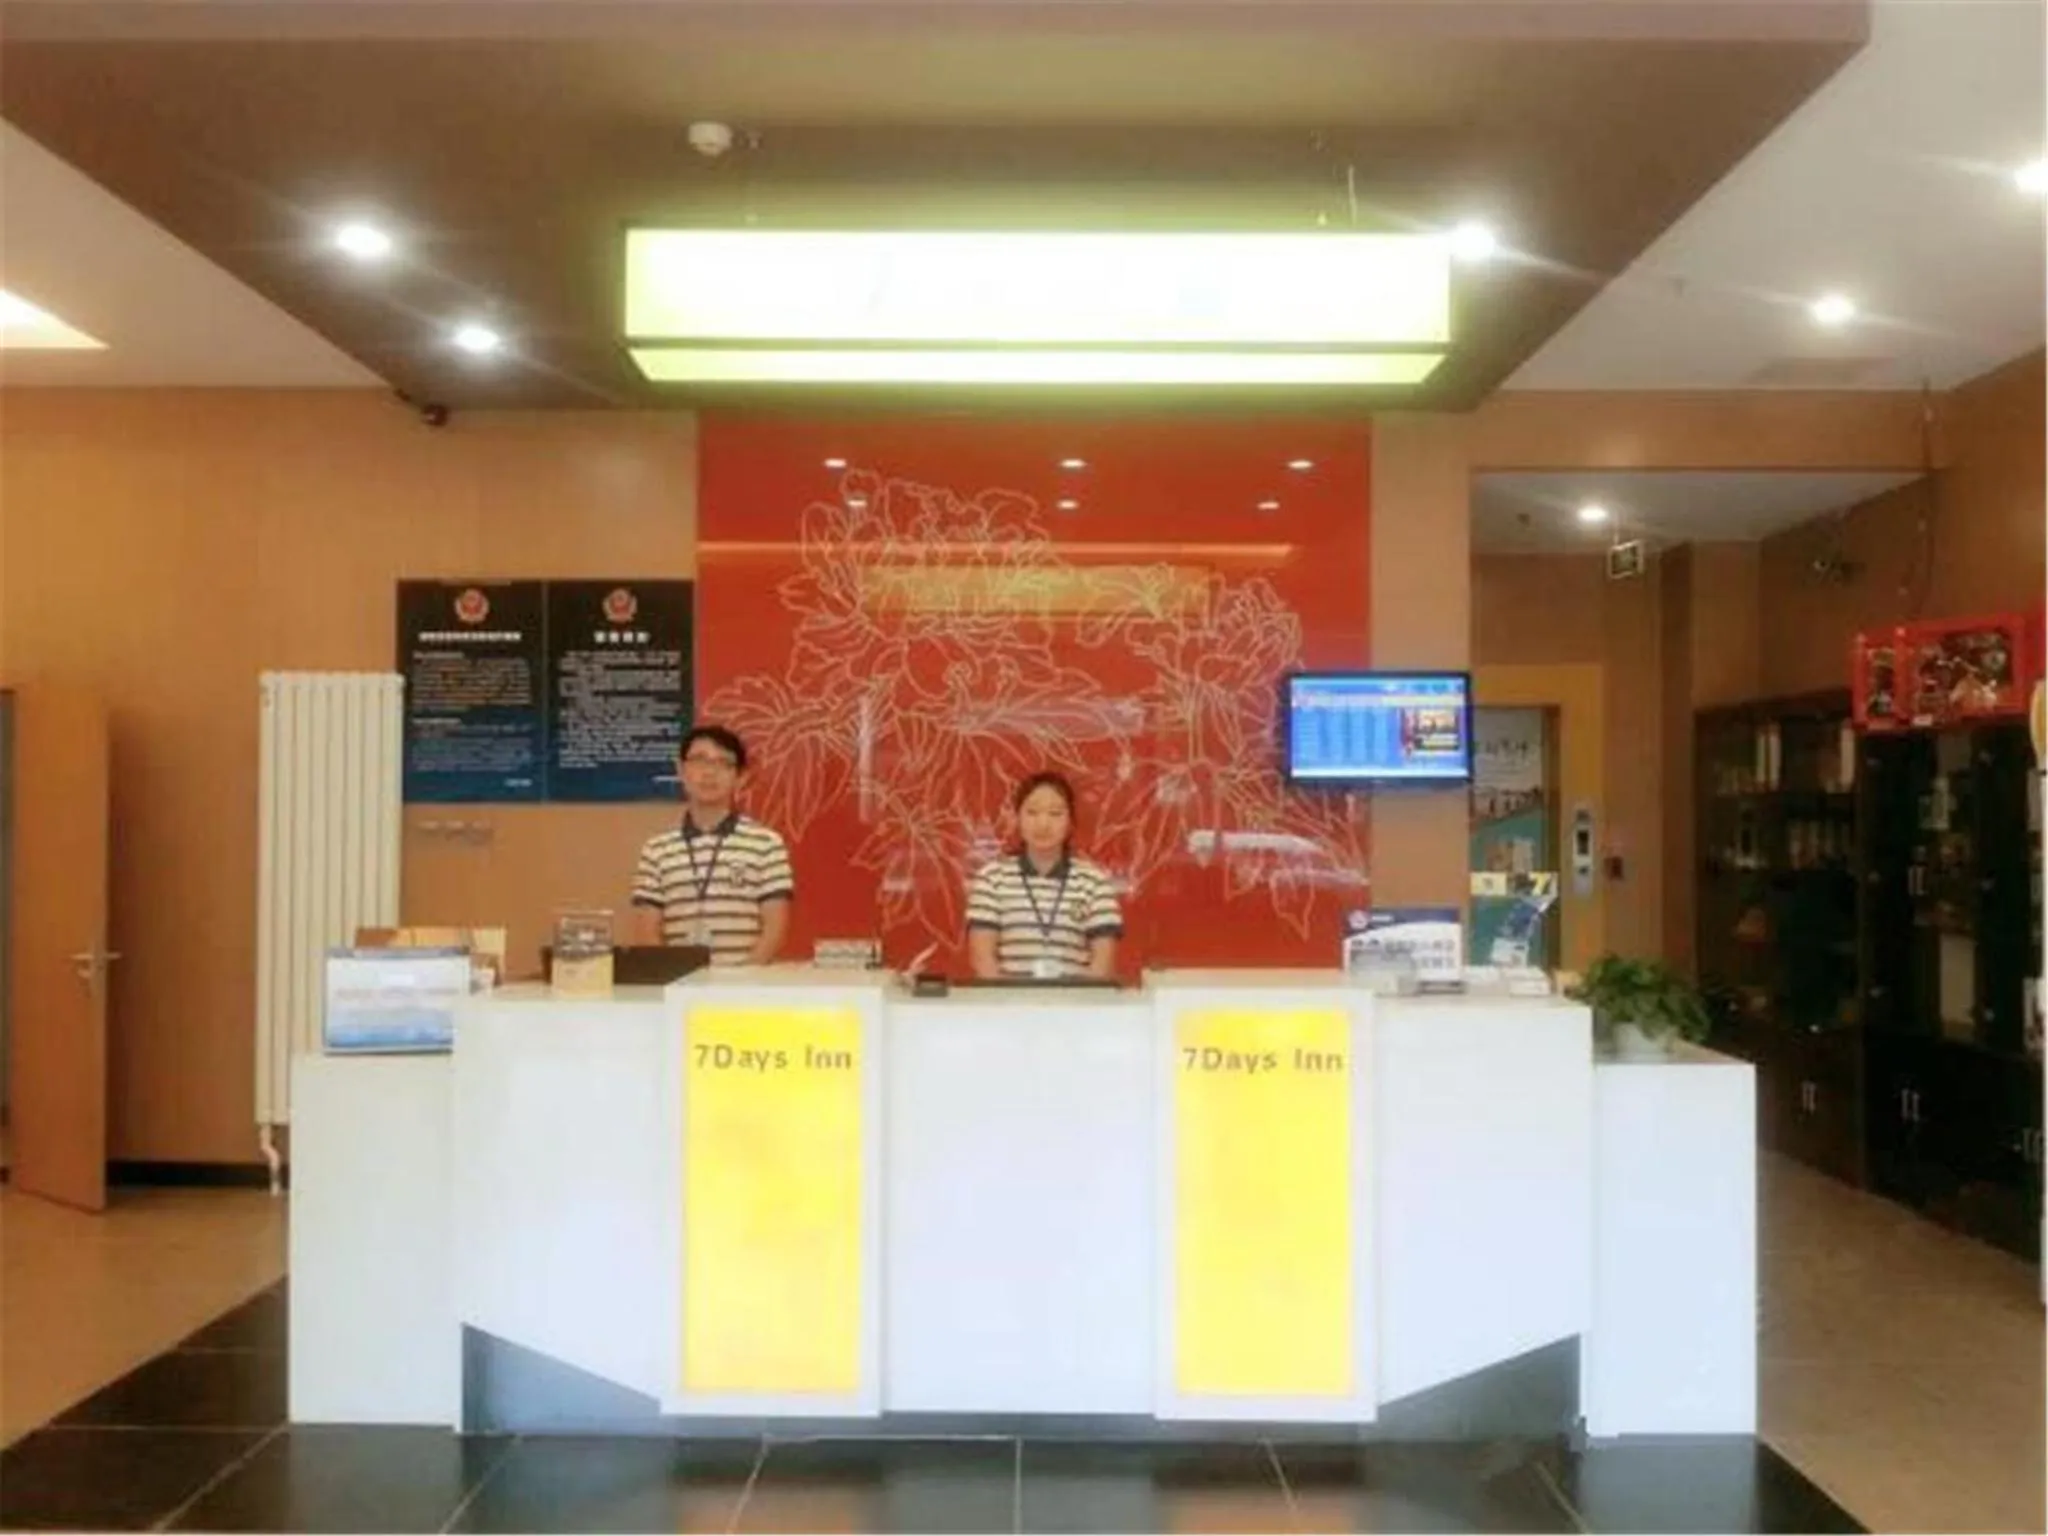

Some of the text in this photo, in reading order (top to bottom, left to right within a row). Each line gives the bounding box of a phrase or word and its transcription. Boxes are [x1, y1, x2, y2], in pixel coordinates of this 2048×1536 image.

[694, 1043, 853, 1073] 7Days Inn
[1182, 1047, 1344, 1074] 7Days Inn
